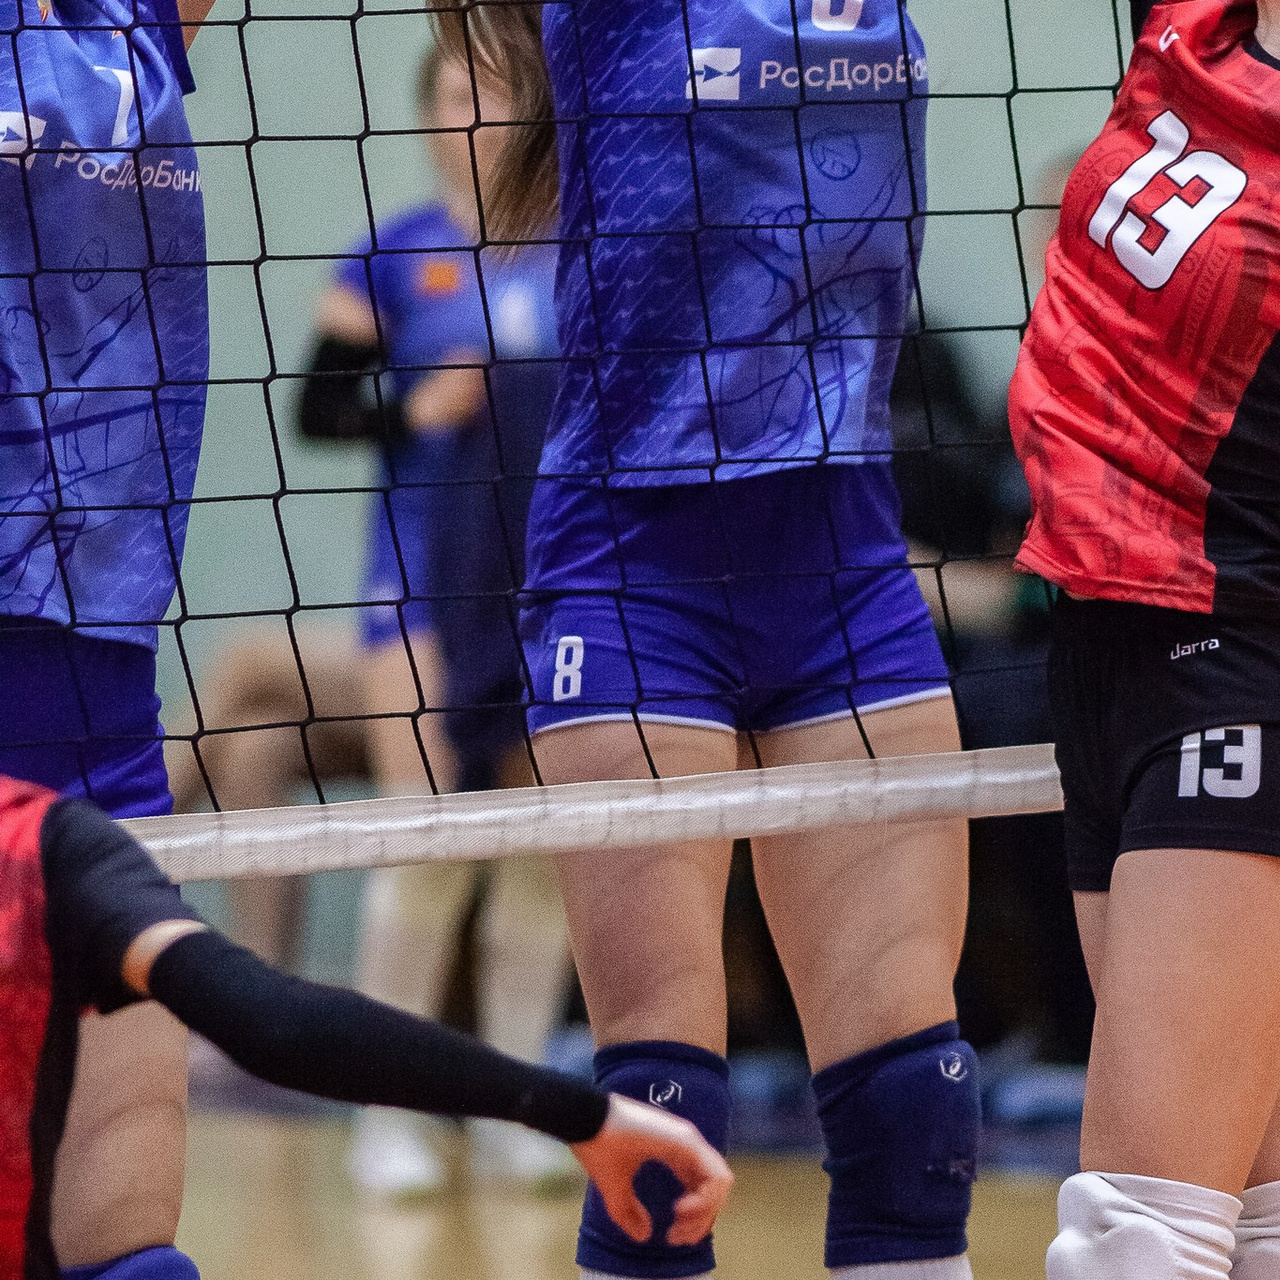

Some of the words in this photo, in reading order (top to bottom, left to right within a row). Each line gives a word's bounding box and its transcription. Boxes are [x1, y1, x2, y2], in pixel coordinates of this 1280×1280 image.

[92, 65, 138, 147] 7
[1087, 109, 1248, 290] 13
[553, 635, 584, 702] 8
[1177, 723, 1262, 799] 13
